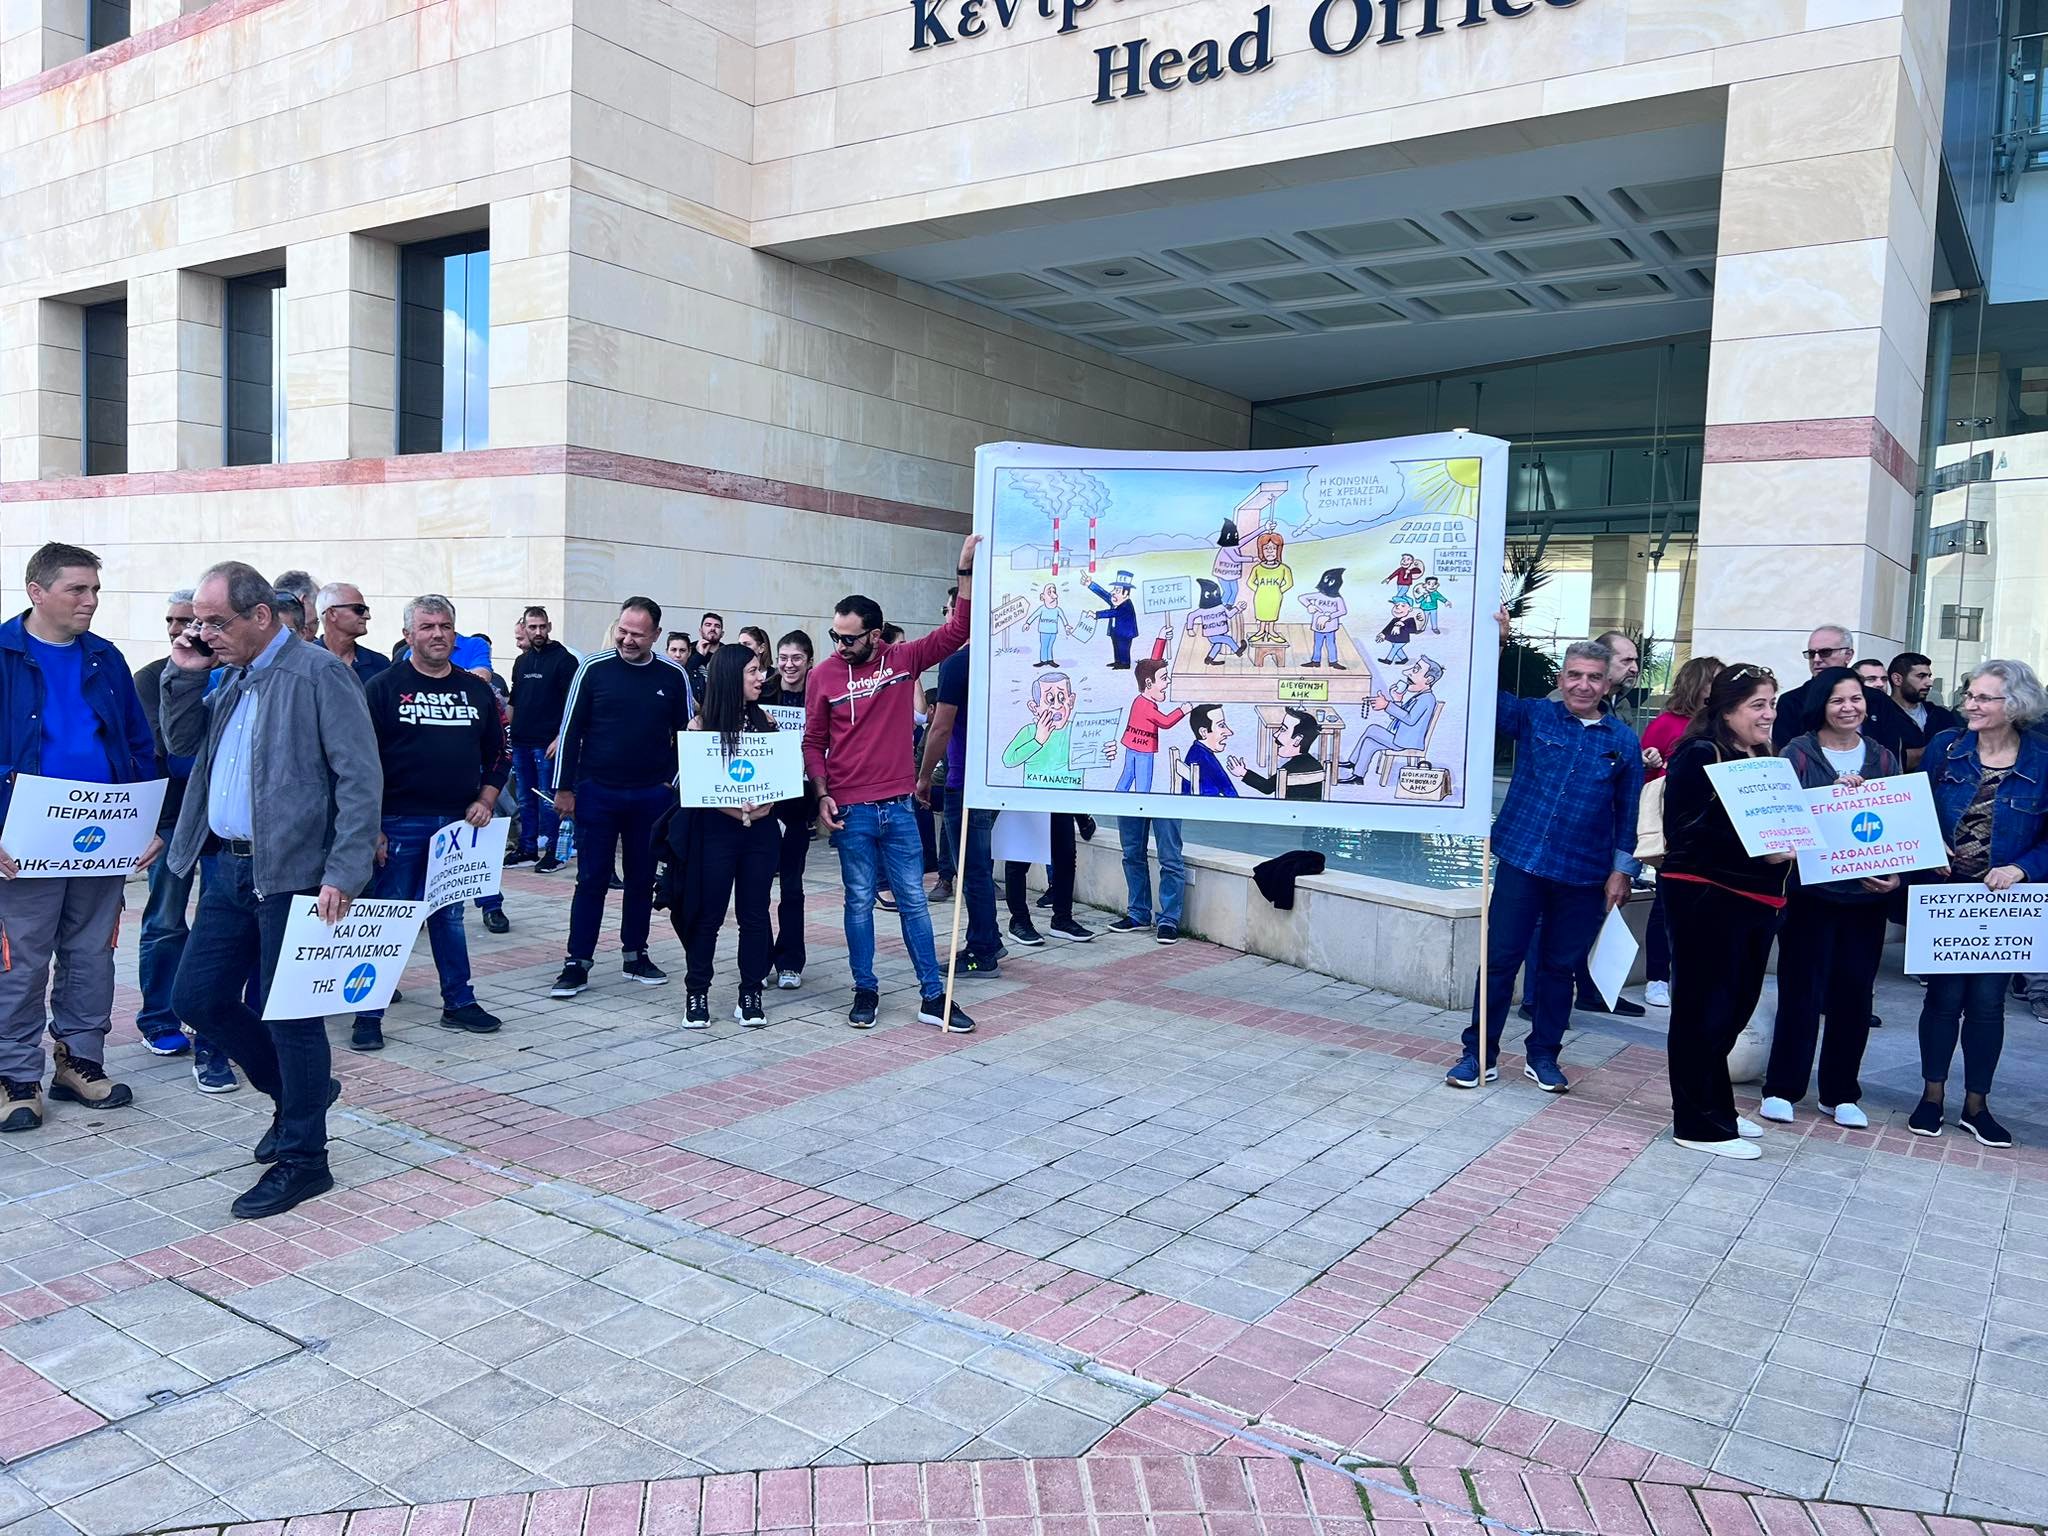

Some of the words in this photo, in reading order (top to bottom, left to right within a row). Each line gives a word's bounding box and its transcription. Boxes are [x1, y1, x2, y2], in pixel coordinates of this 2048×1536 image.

[1091, 5, 1275, 105] Head
[1320, 477, 1326, 486] Η
[1329, 475, 1379, 486] ΚΟΙΝΩΝΙΑ
[1319, 488, 1332, 497] ΜΕ
[1337, 485, 1389, 496] ΧΡΕΙΑΖΕΤΑΙ
[1259, 577, 1280, 586] ΑΗΚ
[1151, 583, 1183, 594] ΣΩΣΤΕ
[1147, 597, 1166, 606] ΤΗΝ
[1168, 595, 1187, 605] ΑΗΚ
[415, 705, 480, 720] NEVER
[1081, 729, 1102, 738] ΑΗΚ
[1131, 737, 1149, 746] ΑΗΚ
[714, 783, 770, 793] ΕΛΛΕΙΠΗΣ
[69, 790, 99, 803] ΟΧΙ
[102, 792, 130, 803] ΣΤΑ
[1810, 791, 1912, 815] ΕΓΚΑΤΑΣΤΑΣΕΩΝ
[47, 806, 138, 819] ΠΕΙΡΑΜΑΤΑ
[1830, 843, 1893, 861] ΑΣΦΑΛΕΙΑ
[1896, 839, 1921, 854] ΤΟΥ
[443, 852, 463, 866] ΣΤΗΝ
[1831, 855, 1915, 875] ΚΑΤΑΝΑΛΩΤΗ
[440, 887, 482, 906] ΔΕΚΕΛΕΙΑ
[307, 903, 416, 918] ΑΓΩΝΙΣΜΟΣ
[1928, 908, 1955, 919] ΤΗΣ
[1958, 907, 2042, 918] ΔΕΚΕΛΕΙΑΣ
[333, 925, 355, 938] ΚΑΙ
[358, 925, 382, 938] ΟΧΙ
[1933, 936, 1990, 947] ΚΕΡΔΟΣ
[1994, 936, 2033, 946] ΣΤΟΝ
[295, 944, 402, 961] ΣΤΡΑΓΓΑΛΙΣΜΟΣ
[1933, 950, 2031, 961] ΚΑΤΑΝΑΛΩΤΗ
[312, 979, 336, 994] ΤΗΣ
